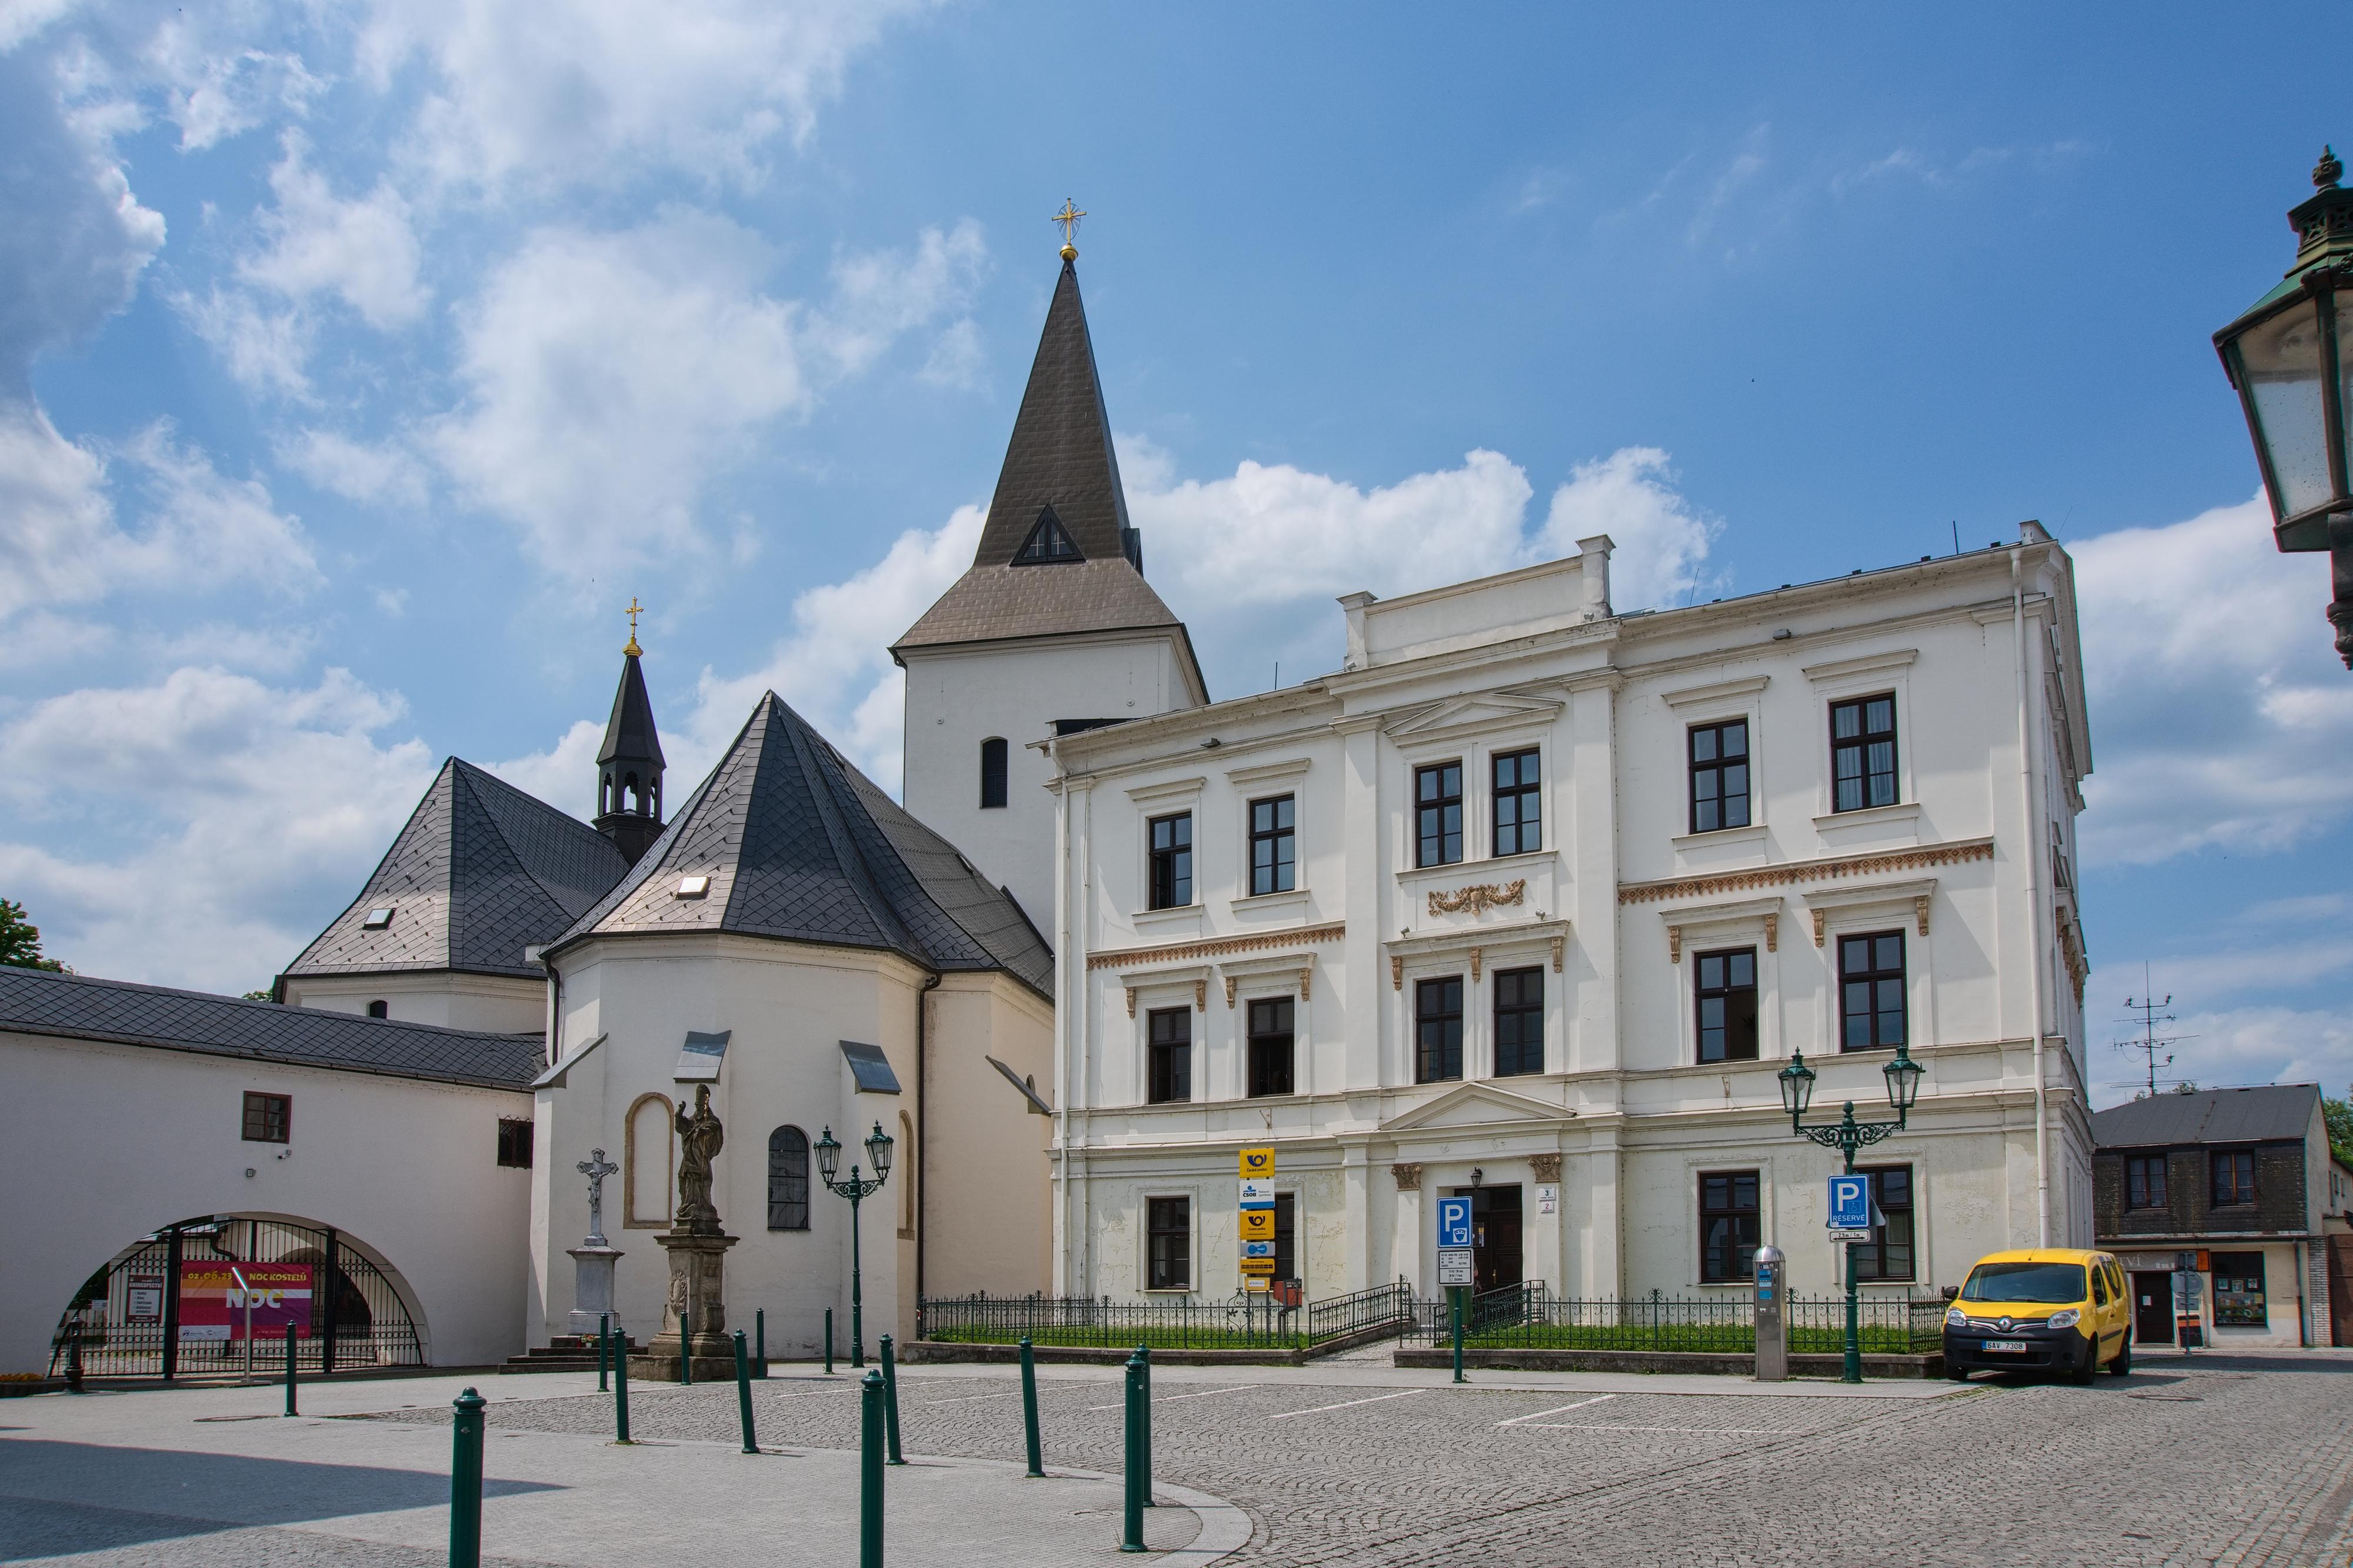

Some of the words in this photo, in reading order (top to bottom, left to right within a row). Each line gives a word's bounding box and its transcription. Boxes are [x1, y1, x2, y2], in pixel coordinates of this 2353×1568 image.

[1838, 1183, 1859, 1212] P
[1445, 1205, 1464, 1232] P
[2117, 1254, 2141, 1266] TVÍ
[188, 1270, 232, 1280] 02.06.23
[226, 1289, 281, 1309] NOC
